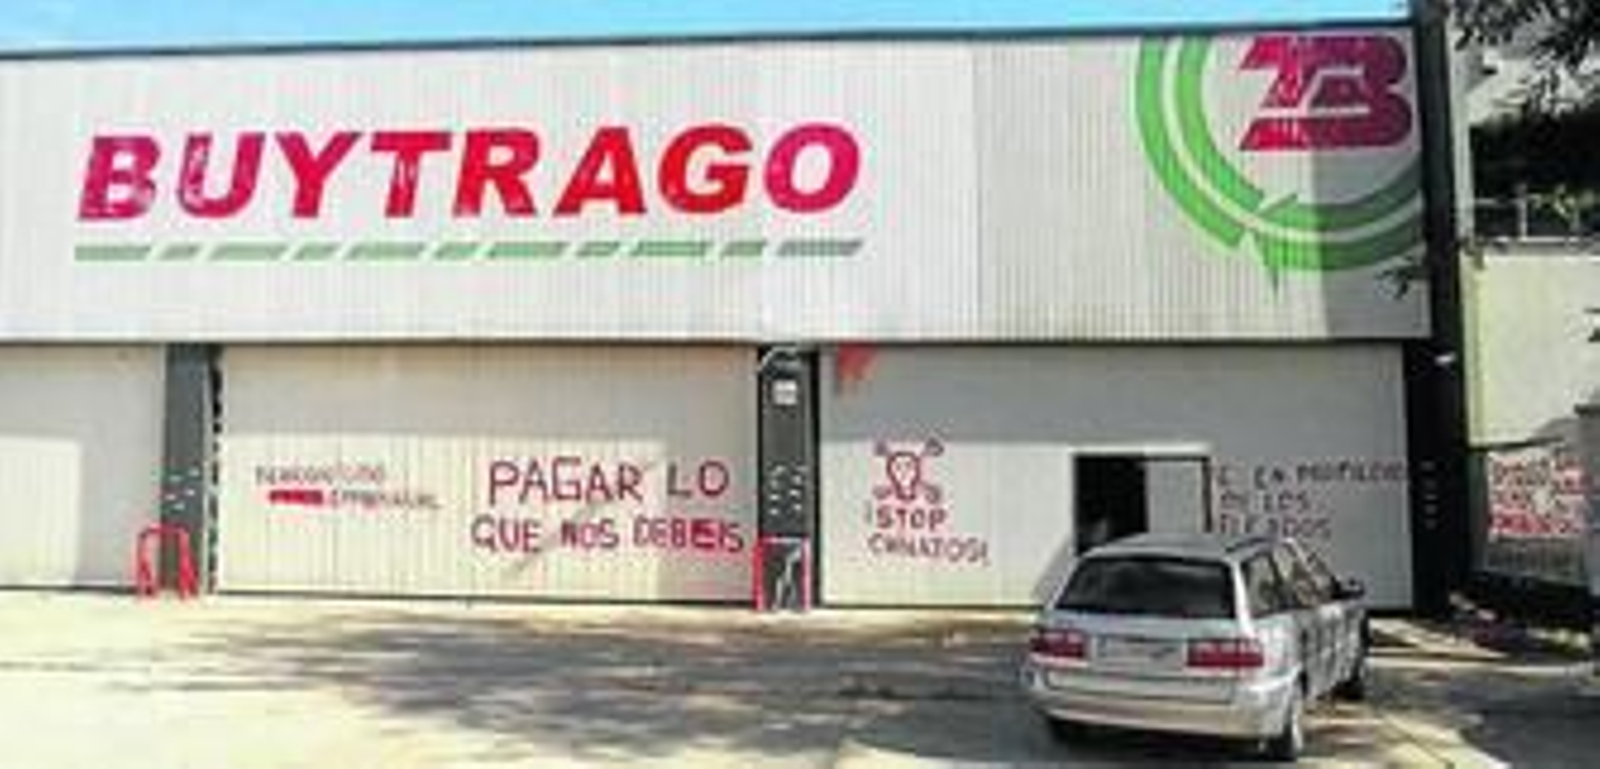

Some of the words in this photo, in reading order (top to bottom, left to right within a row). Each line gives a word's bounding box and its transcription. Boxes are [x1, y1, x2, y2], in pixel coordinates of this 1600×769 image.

[76, 122, 863, 221] BUYTRAGO
[488, 455, 643, 508] PAGAR
[667, 459, 731, 499] LO
[469, 512, 543, 554] QUE
[560, 518, 621, 550] NOS
[633, 515, 746, 555] DEBEIS
